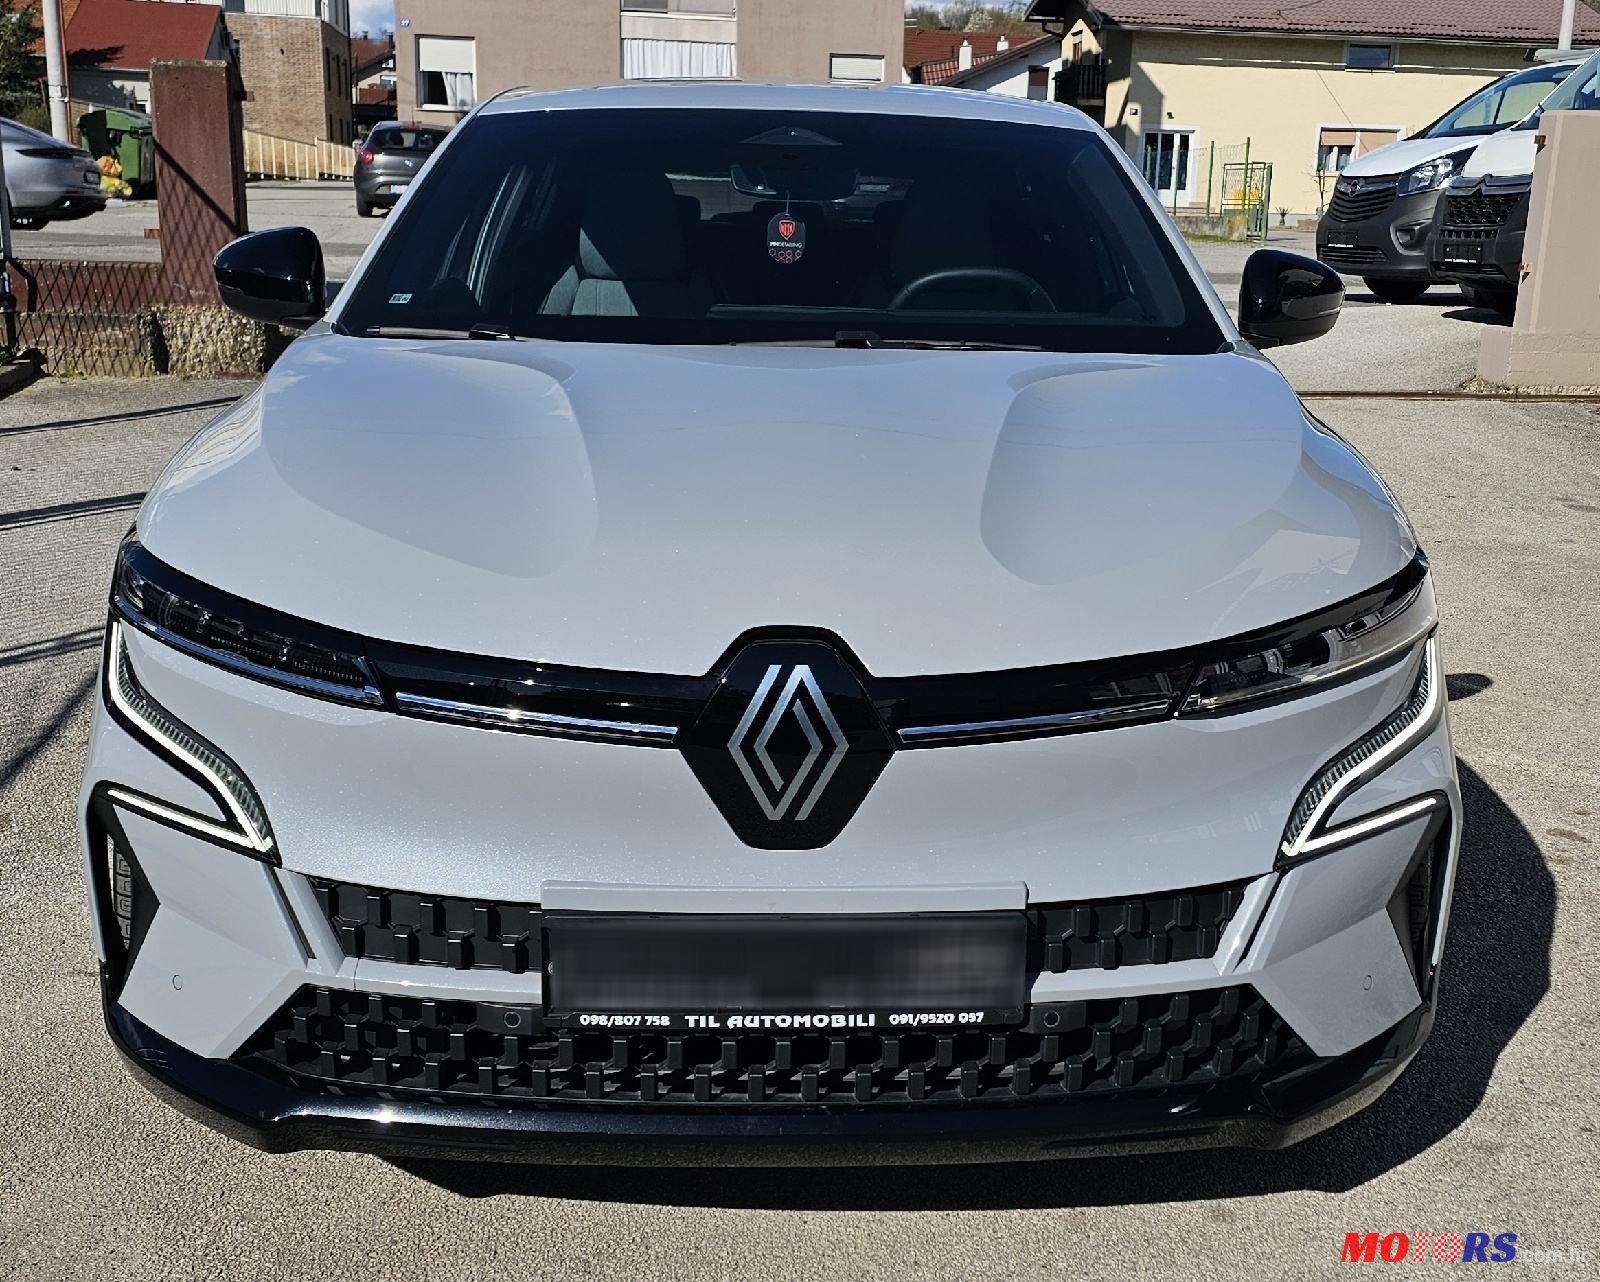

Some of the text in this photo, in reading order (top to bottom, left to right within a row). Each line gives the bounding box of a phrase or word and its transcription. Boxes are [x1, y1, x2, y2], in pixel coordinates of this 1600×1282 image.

[579, 1014, 642, 1028] 098/807
[644, 1015, 671, 1026] 758
[684, 1015, 721, 1028] TIL
[727, 1014, 876, 1029] AUTOMOBILI
[889, 1013, 955, 1026] 091/9520
